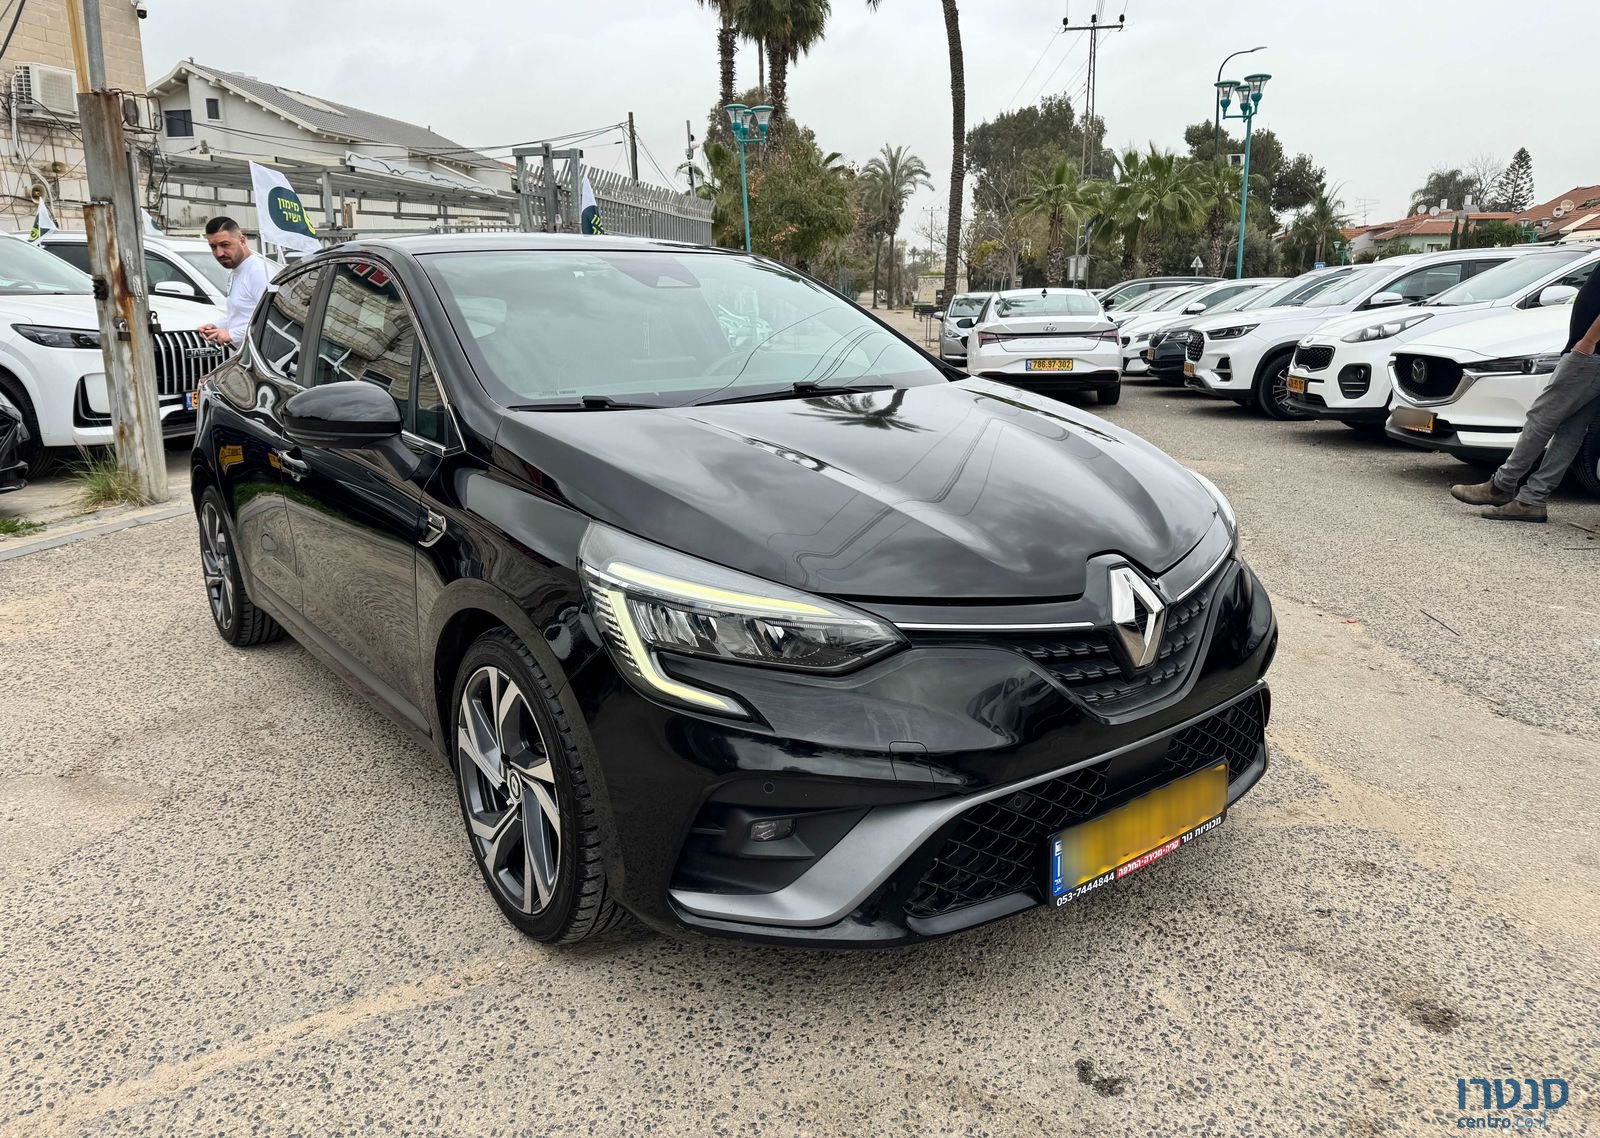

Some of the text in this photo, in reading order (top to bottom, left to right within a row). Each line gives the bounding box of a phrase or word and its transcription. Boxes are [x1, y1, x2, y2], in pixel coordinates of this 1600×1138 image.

[277, 197, 300, 212] מימון
[283, 211, 302, 223] ישיר
[1181, 816, 1222, 845] מכוניות גור
[1056, 871, 1115, 907] 053-7444844
